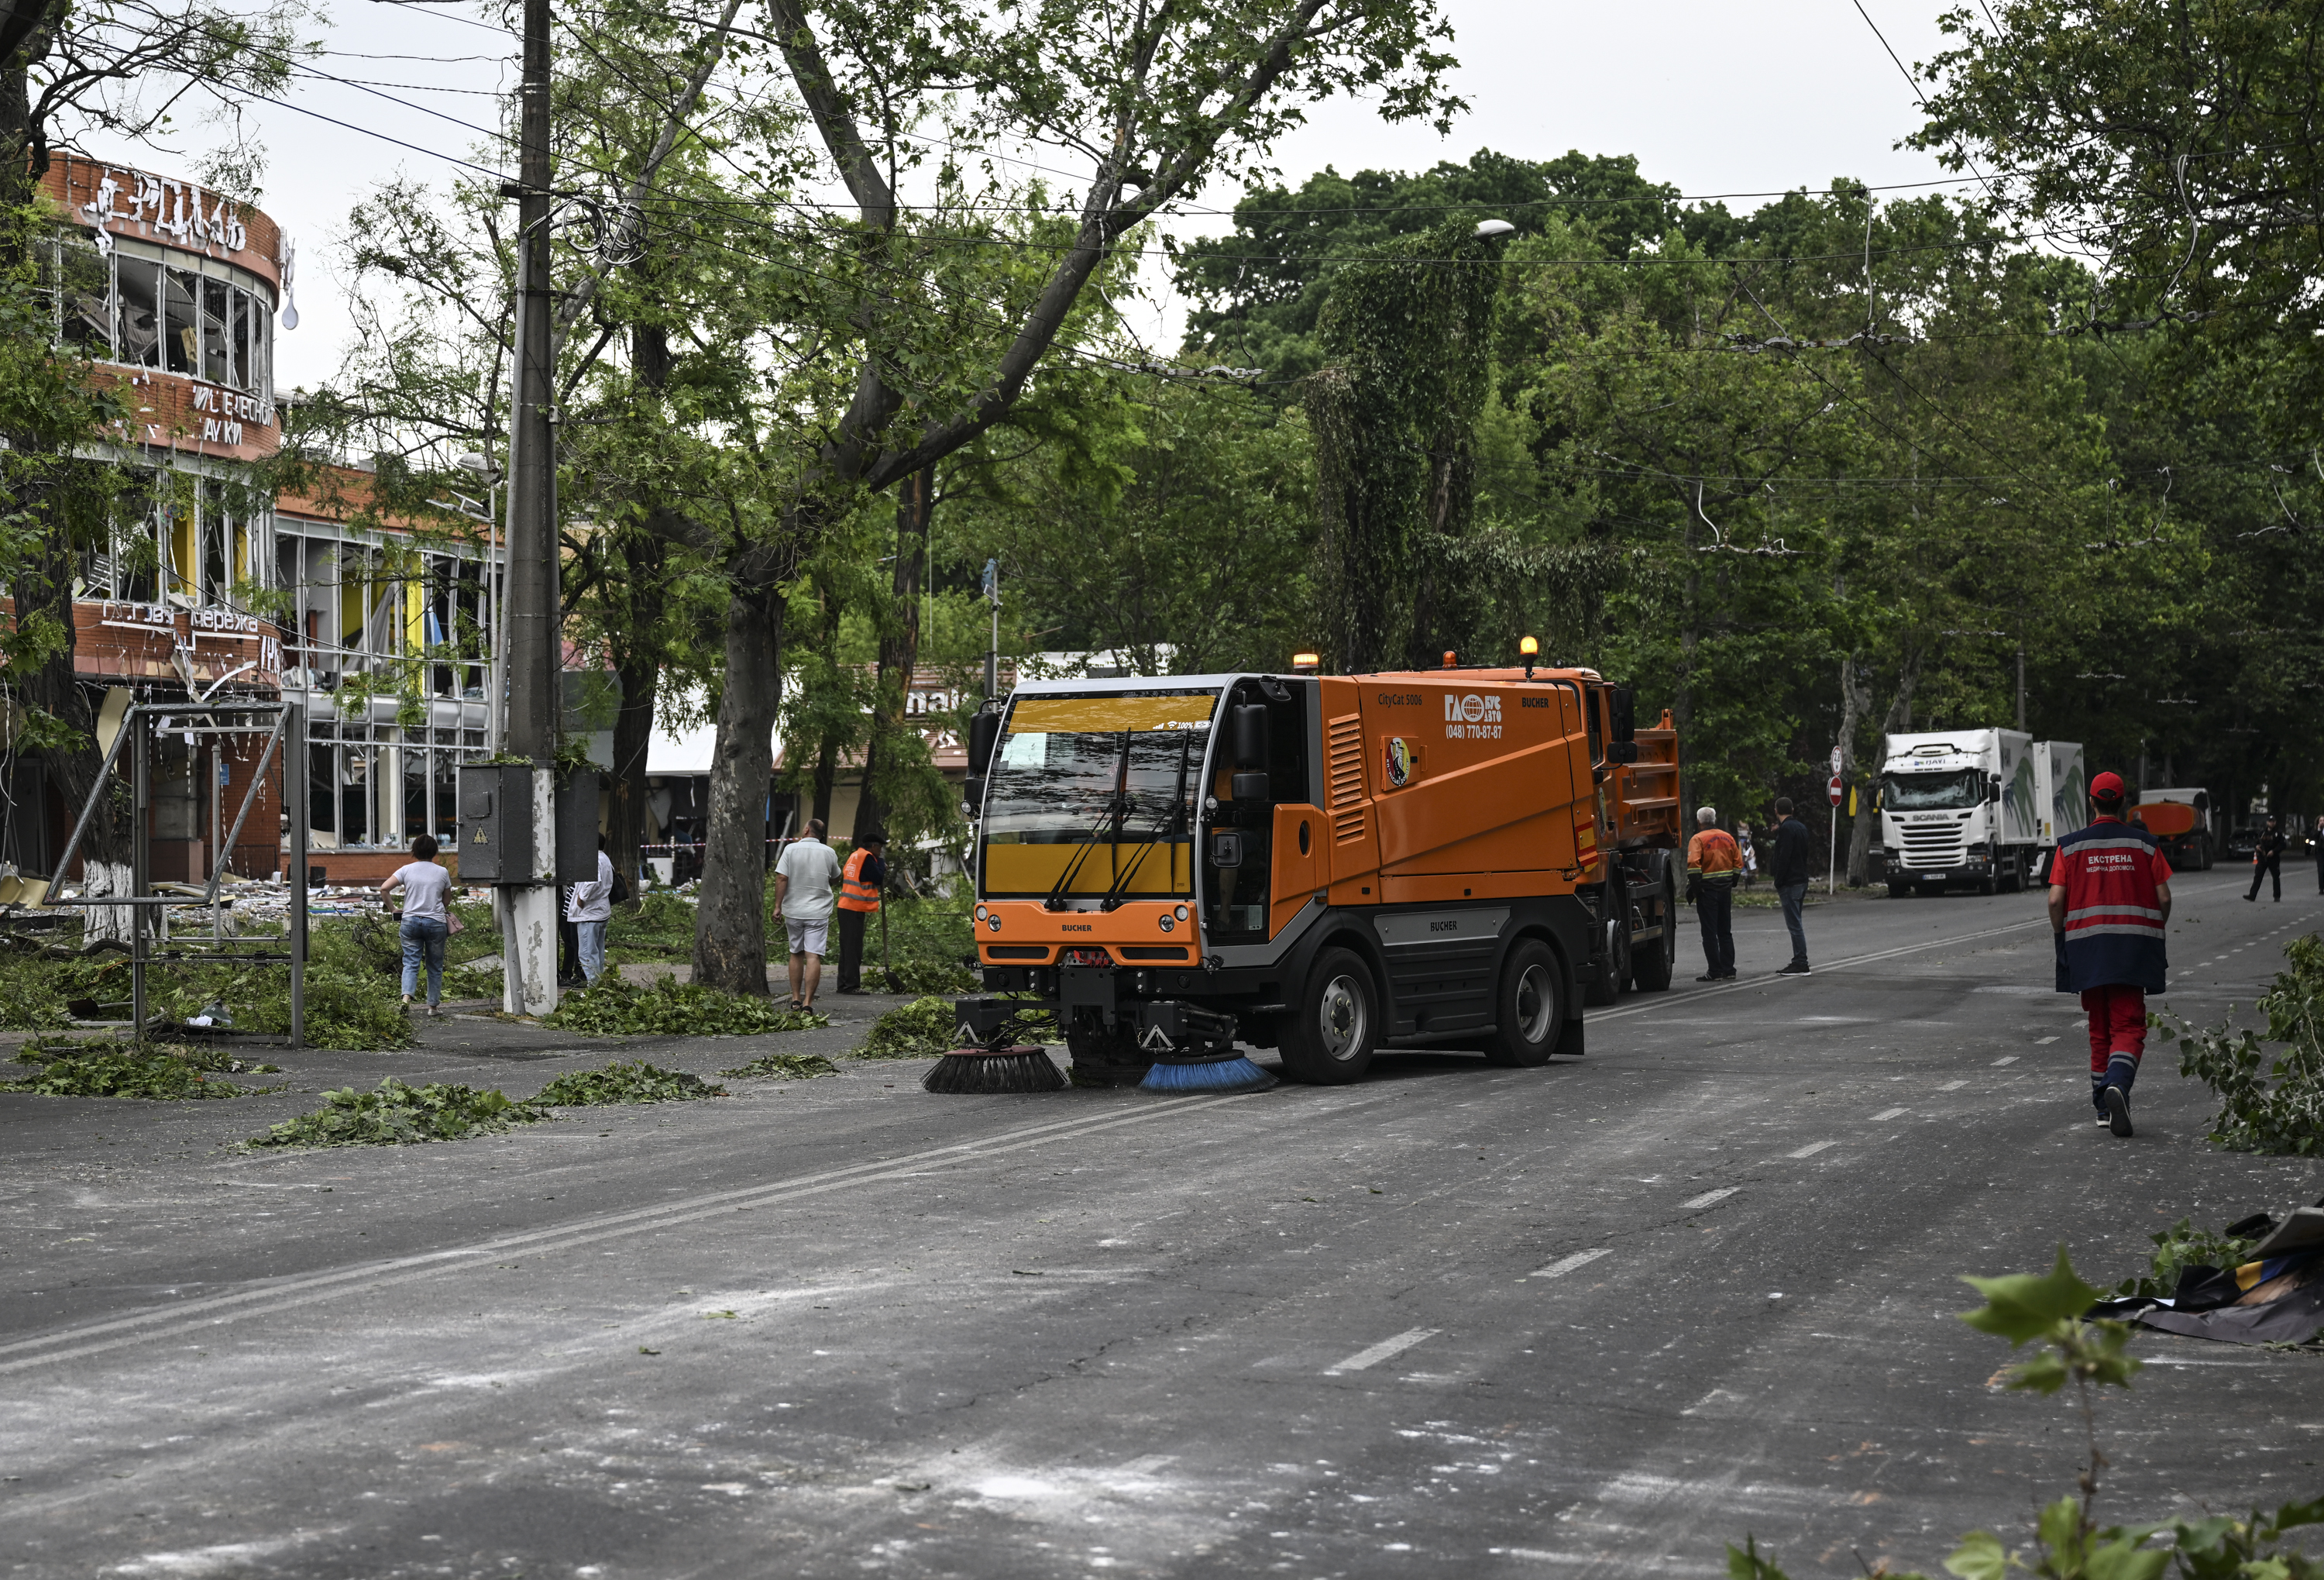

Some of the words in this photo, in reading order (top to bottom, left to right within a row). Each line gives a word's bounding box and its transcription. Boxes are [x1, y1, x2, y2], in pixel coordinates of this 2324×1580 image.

[199, 417, 242, 446] АУКИ
[1378, 693, 1404, 708] CityCat
[1406, 694, 1422, 705] 5006
[1522, 697, 1549, 708] BUCHER
[1446, 725, 1465, 739] (048)
[1466, 725, 1502, 739] 770-87-87
[2088, 854, 2133, 865] ЕКСТРЕНА
[1430, 921, 1458, 932] BUCHER
